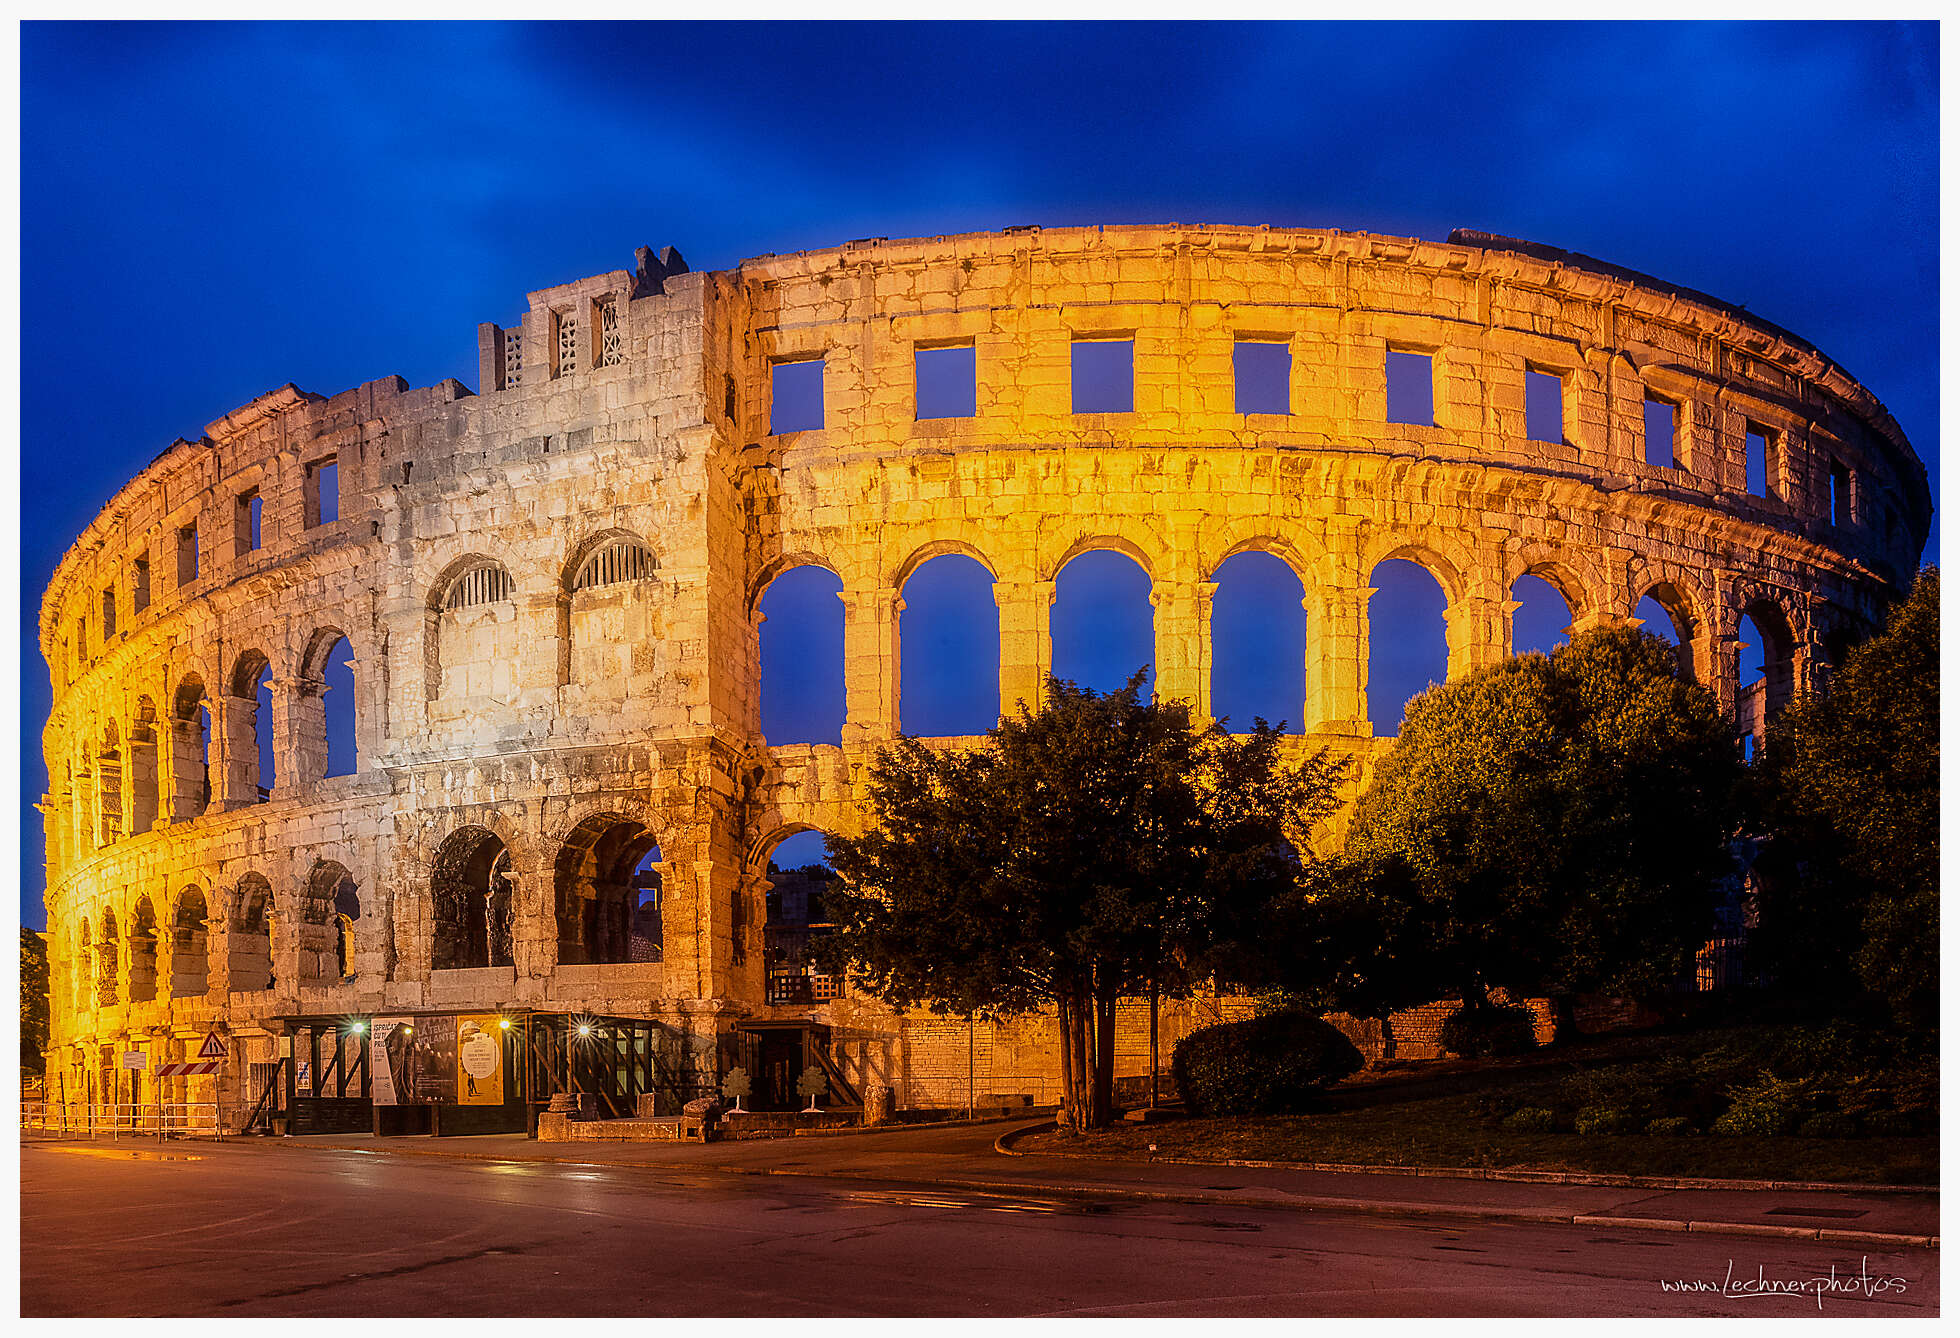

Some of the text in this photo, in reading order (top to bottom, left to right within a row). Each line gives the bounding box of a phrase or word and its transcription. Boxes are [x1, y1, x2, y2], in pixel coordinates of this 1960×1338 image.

[417, 1023, 449, 1036] LA TELA
[417, 1031, 456, 1044] VOLANTE
